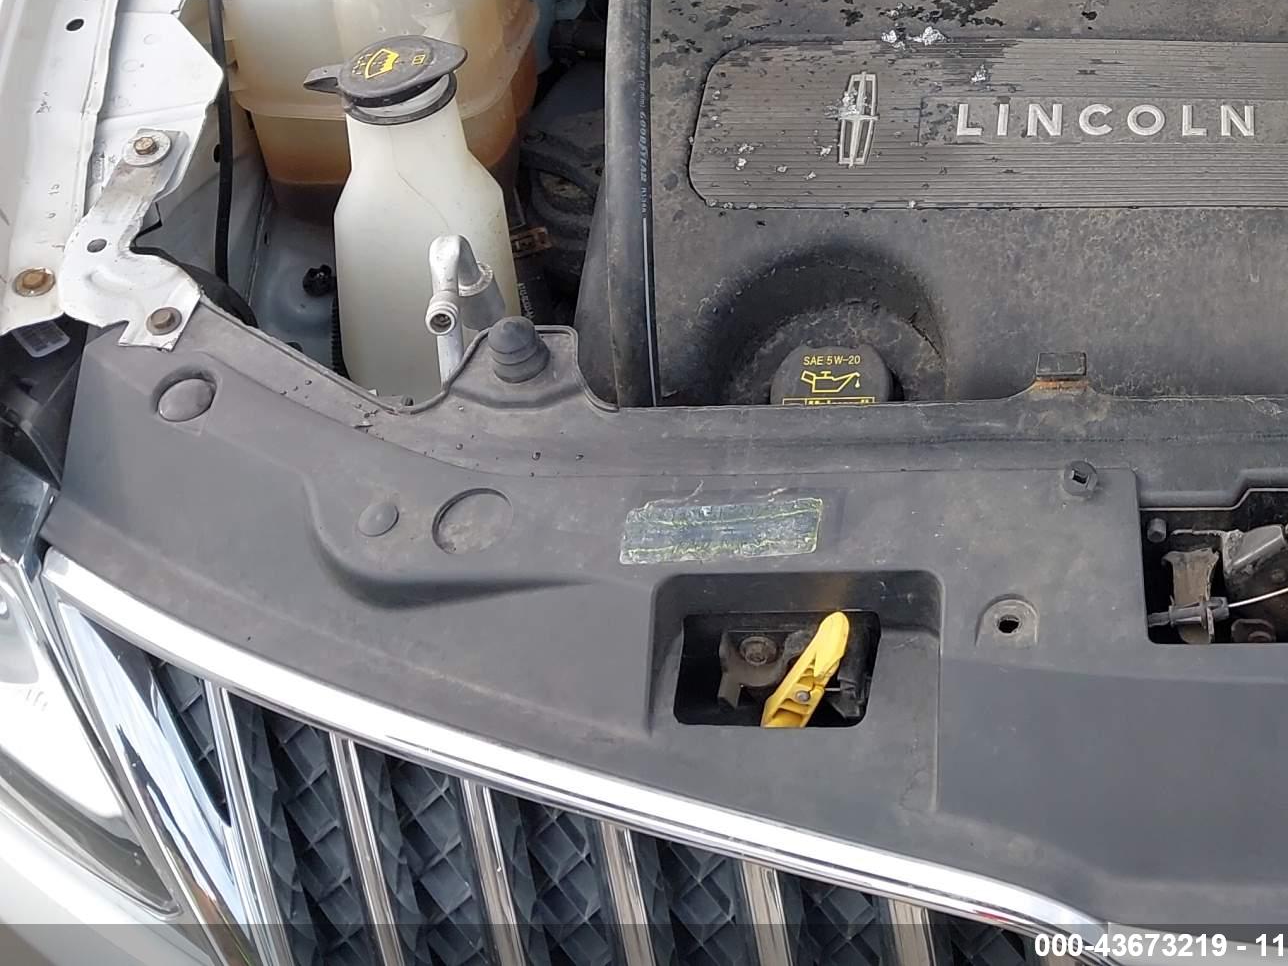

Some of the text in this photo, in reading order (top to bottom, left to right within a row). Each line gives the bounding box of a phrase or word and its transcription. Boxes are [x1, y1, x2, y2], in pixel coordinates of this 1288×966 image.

[956, 102, 1256, 137] LINCOLN
[803, 355, 861, 366] SAE 5W-20
